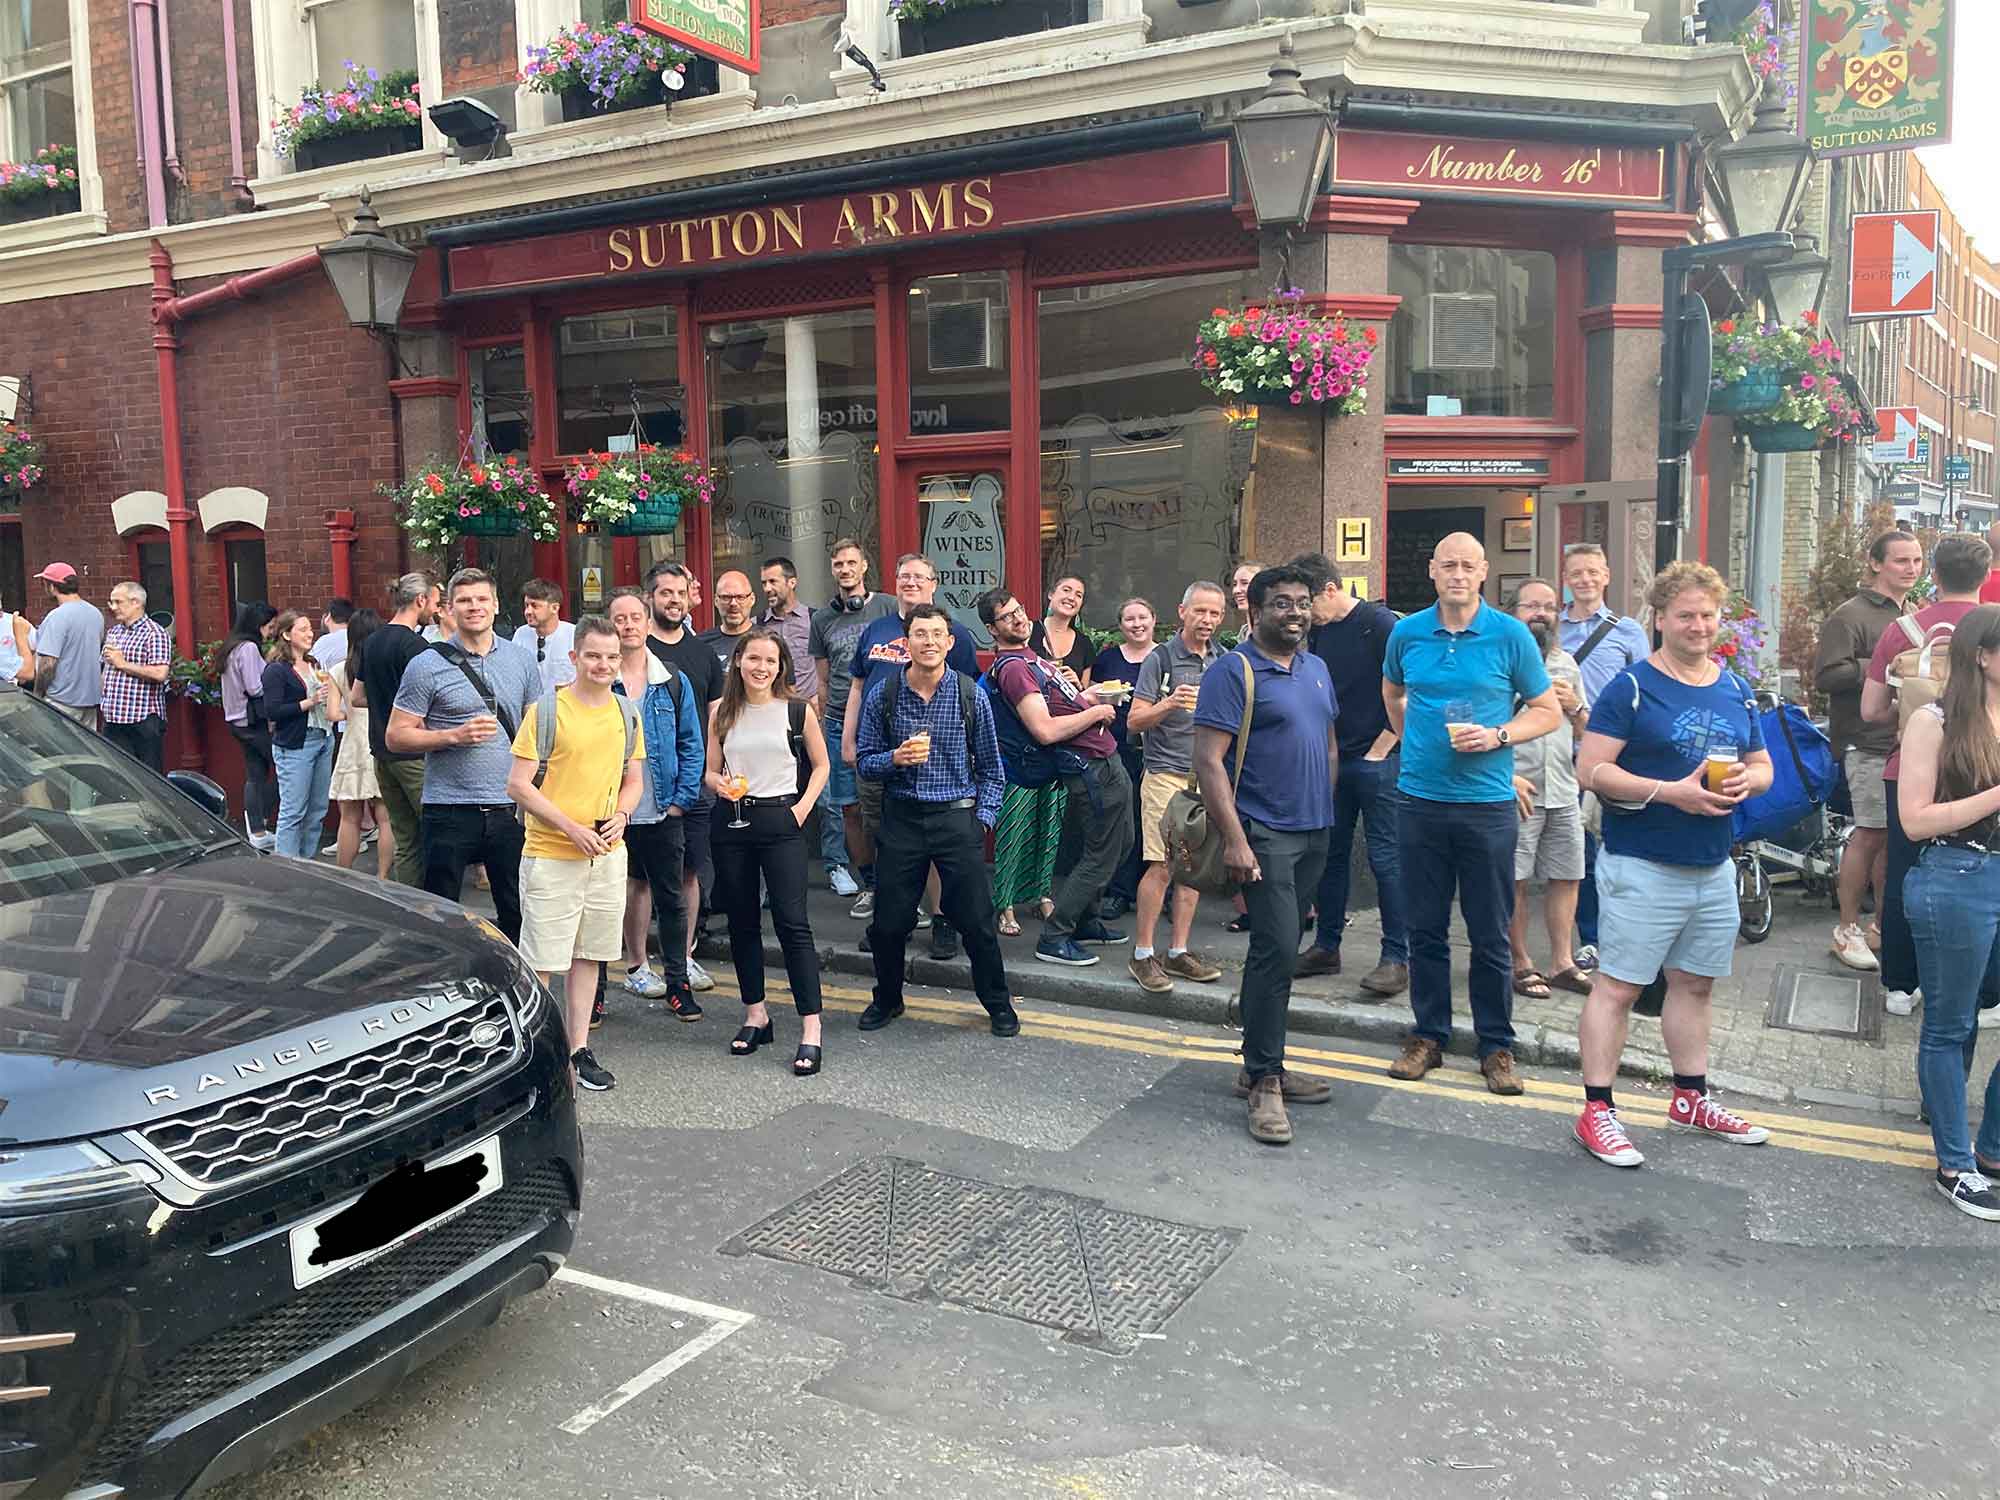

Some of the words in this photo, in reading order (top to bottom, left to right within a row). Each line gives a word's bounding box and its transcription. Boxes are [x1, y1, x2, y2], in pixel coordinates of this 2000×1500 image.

[647, 0, 707, 37] SUTTON
[709, 27, 745, 55] ARMS
[1811, 128, 1883, 150] SUTTON
[1888, 122, 1937, 141] ARMS
[1407, 144, 1543, 183] Number
[1561, 158, 1597, 184] 16
[608, 204, 804, 272] SUTTON
[832, 178, 994, 245] ARMS
[1880, 270, 1911, 281] Rent
[935, 535, 994, 552] WINES
[956, 553, 971, 568] &
[936, 569, 998, 585] PIRITS
[361, 977, 486, 1036] ROVER
[144, 1035, 335, 1106] RANGE
